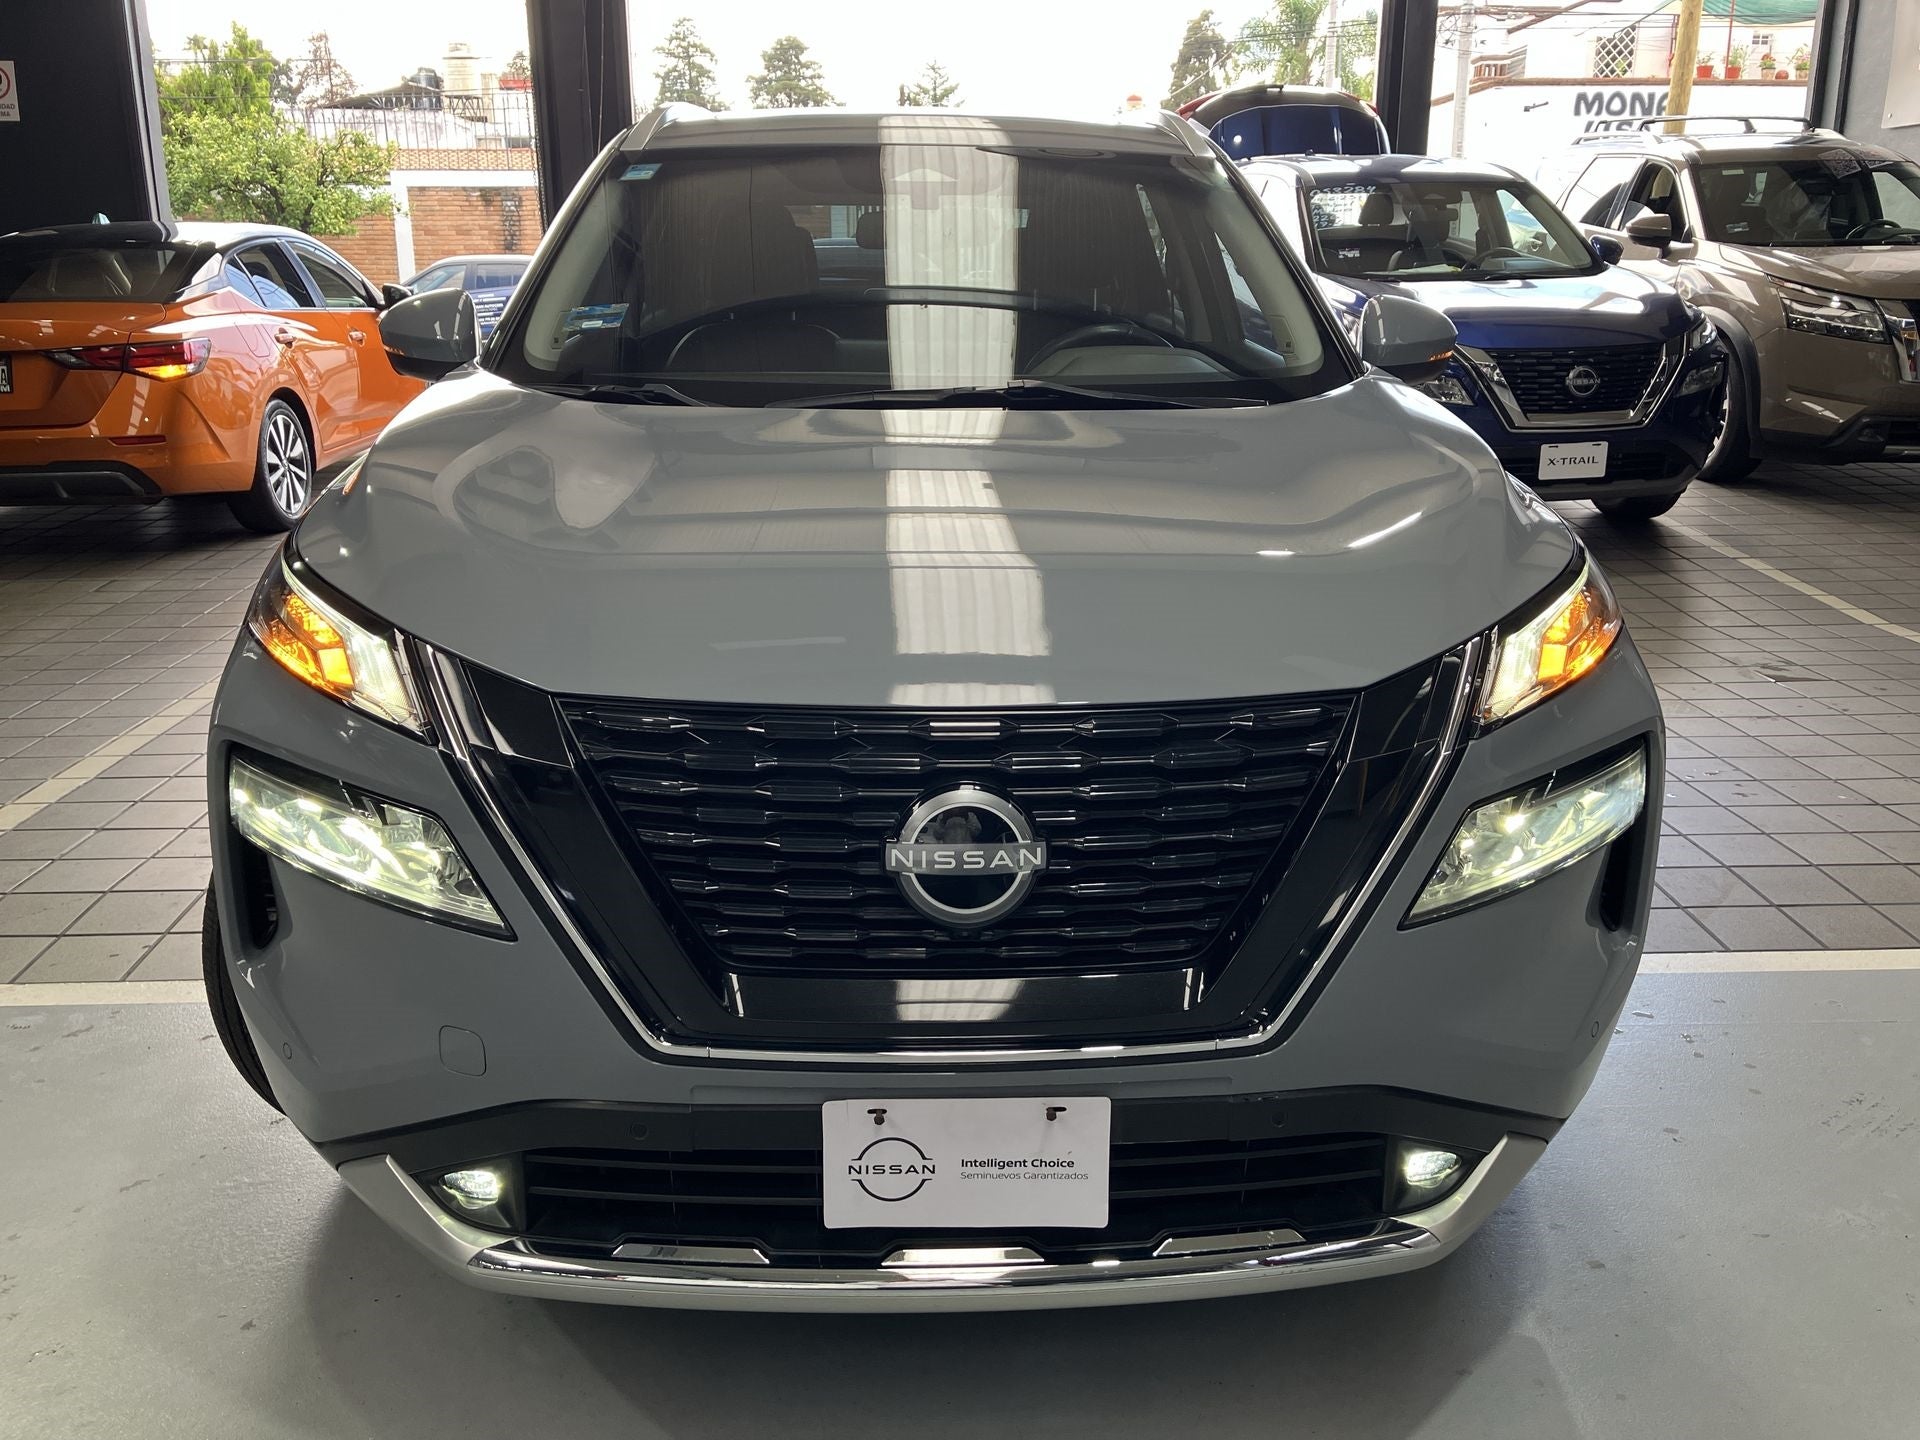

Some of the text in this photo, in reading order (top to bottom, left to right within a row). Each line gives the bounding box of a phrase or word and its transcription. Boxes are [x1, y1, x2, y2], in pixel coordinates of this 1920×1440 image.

[1547, 456, 1599, 466] X-TRAIL
[891, 847, 1042, 869] NISSAN
[848, 1164, 936, 1175] NISSAN
[961, 1158, 1075, 1170] Intelligent Choice
[960, 1170, 1089, 1180] Seminuevos Garantizados
